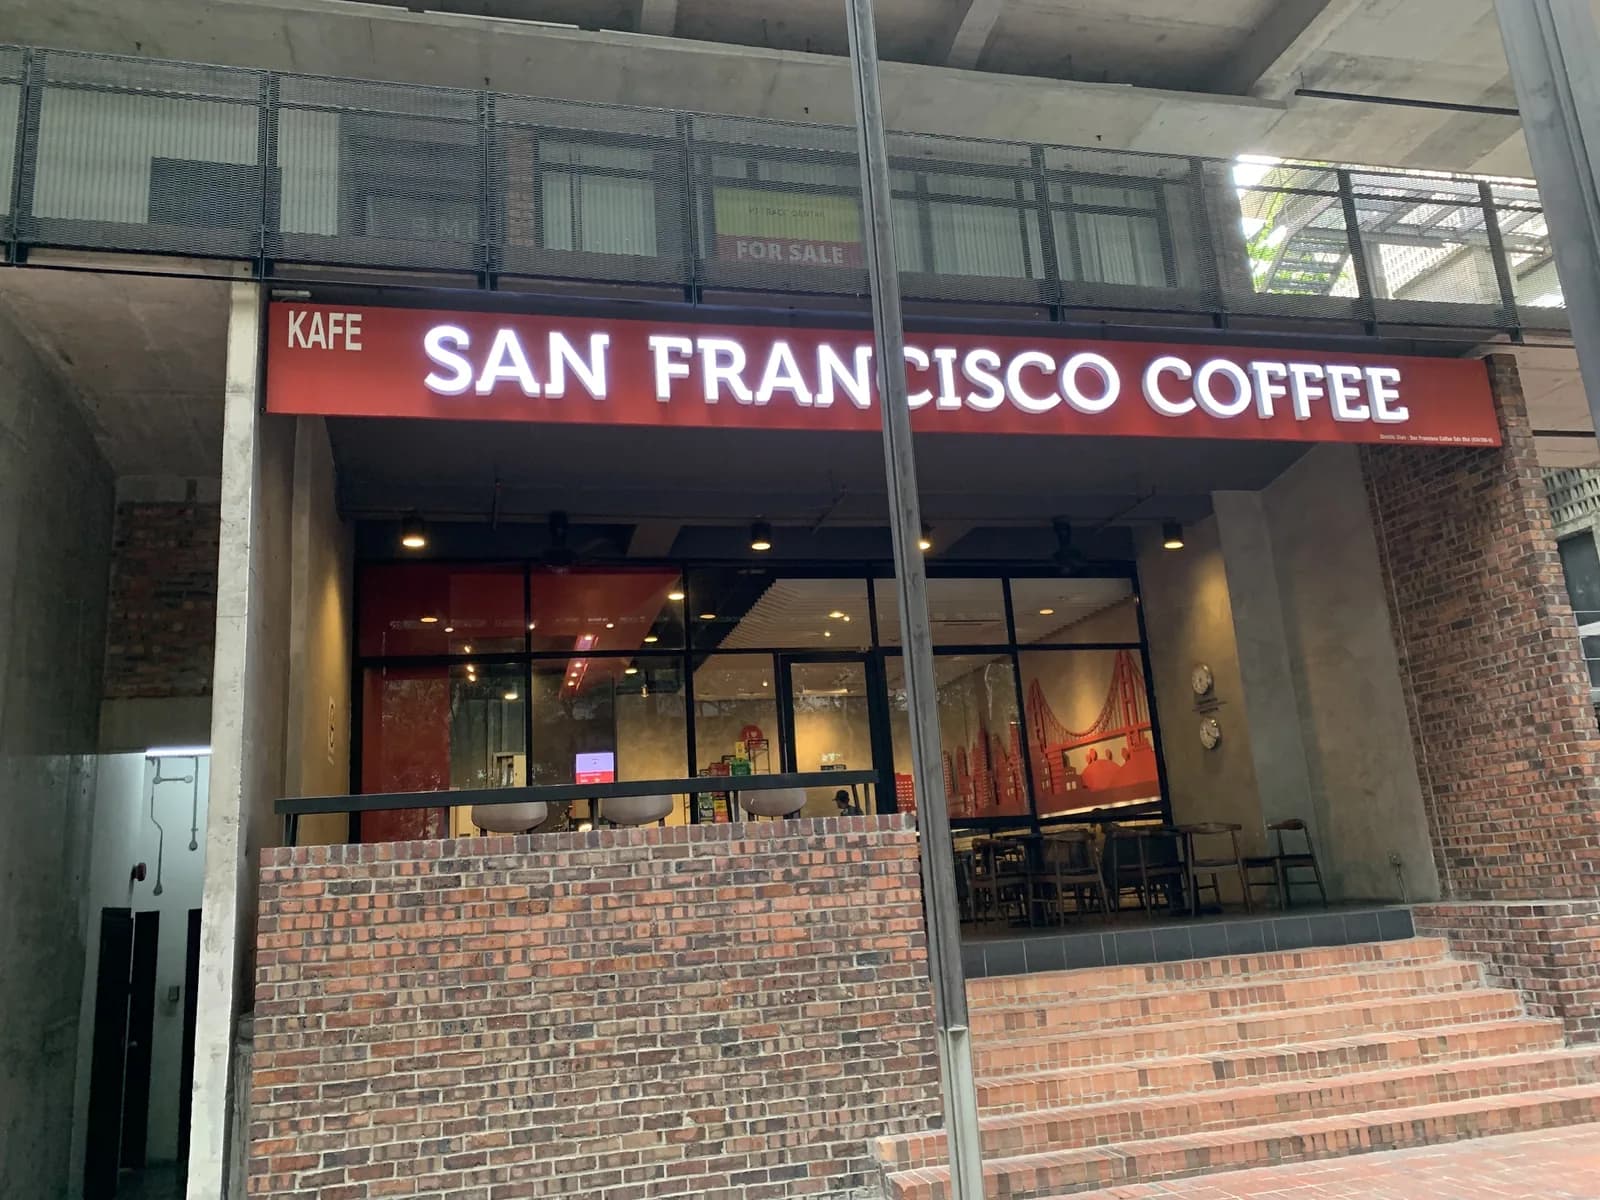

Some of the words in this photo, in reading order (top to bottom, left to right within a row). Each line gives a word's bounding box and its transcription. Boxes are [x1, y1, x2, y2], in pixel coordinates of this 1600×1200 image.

[736, 240, 783, 260] FOR
[789, 244, 844, 264] SALE
[288, 310, 362, 351] KAFE
[423, 324, 610, 400] SAN
[1142, 356, 1409, 423] COFFEE
